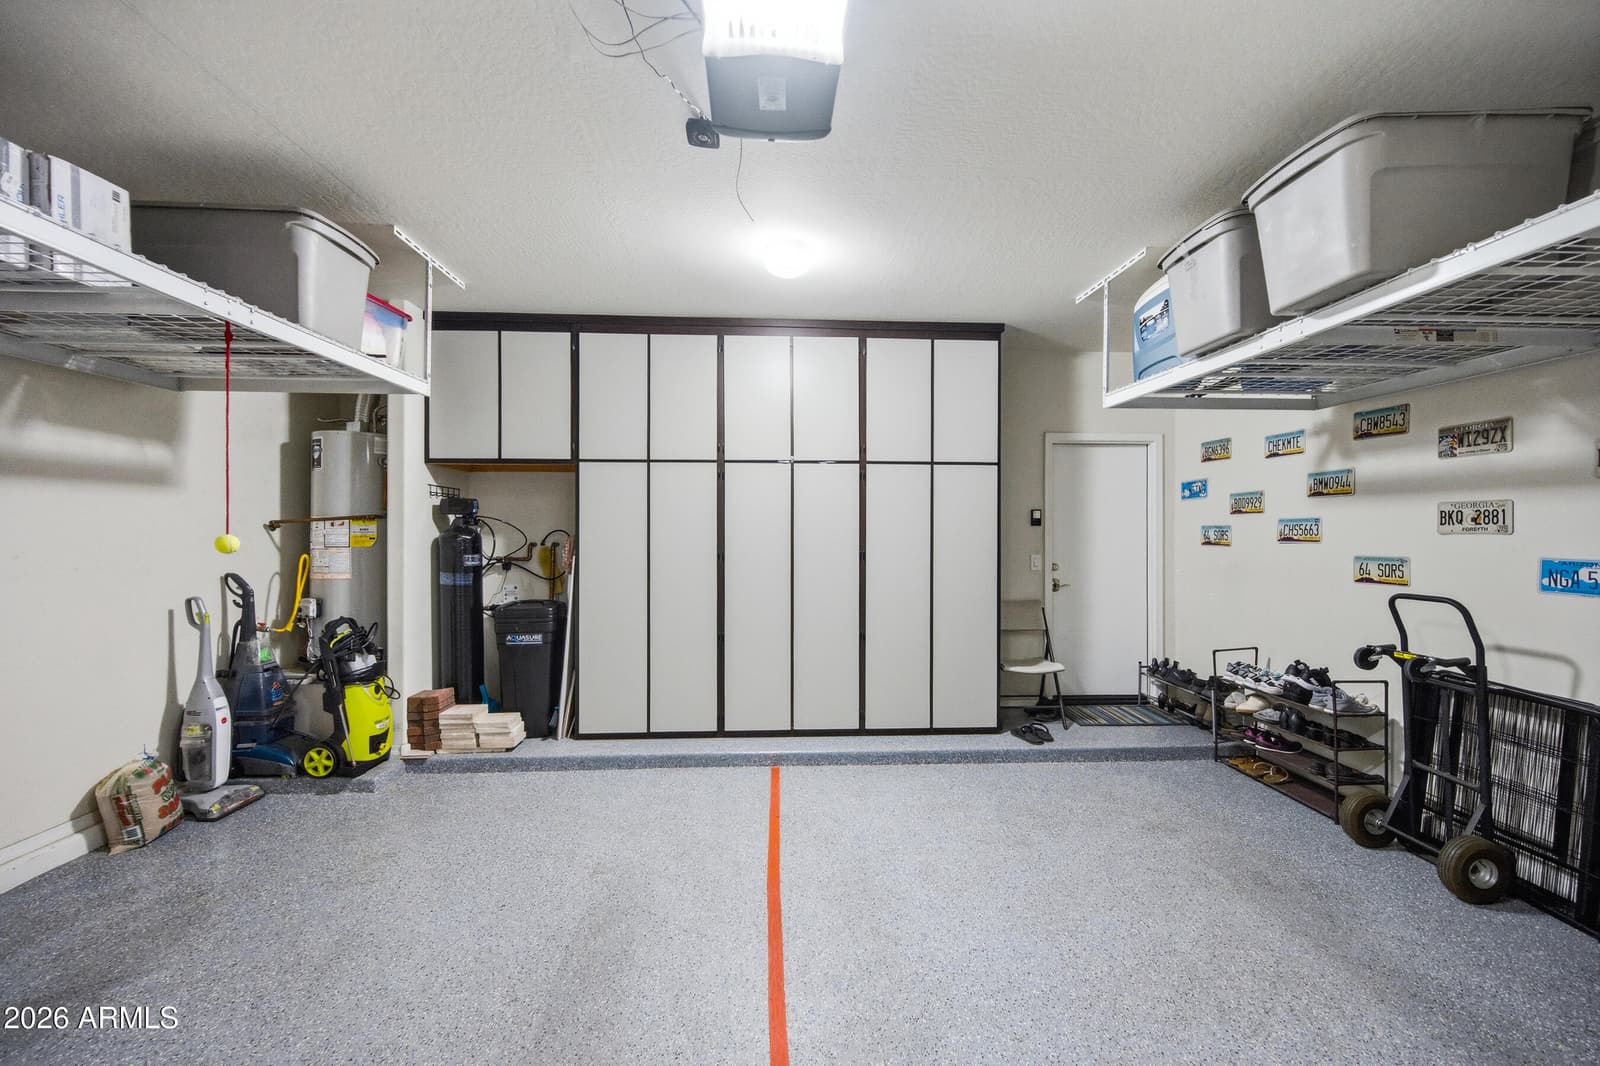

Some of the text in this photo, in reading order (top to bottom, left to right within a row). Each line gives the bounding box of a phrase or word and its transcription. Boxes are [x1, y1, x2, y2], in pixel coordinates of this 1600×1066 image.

[1454, 501, 1495, 509] GEORGIA
[1440, 508, 1506, 526] BKQ 2881
[1358, 561, 1371, 577] 64
[1548, 568, 1580, 589] NGA
